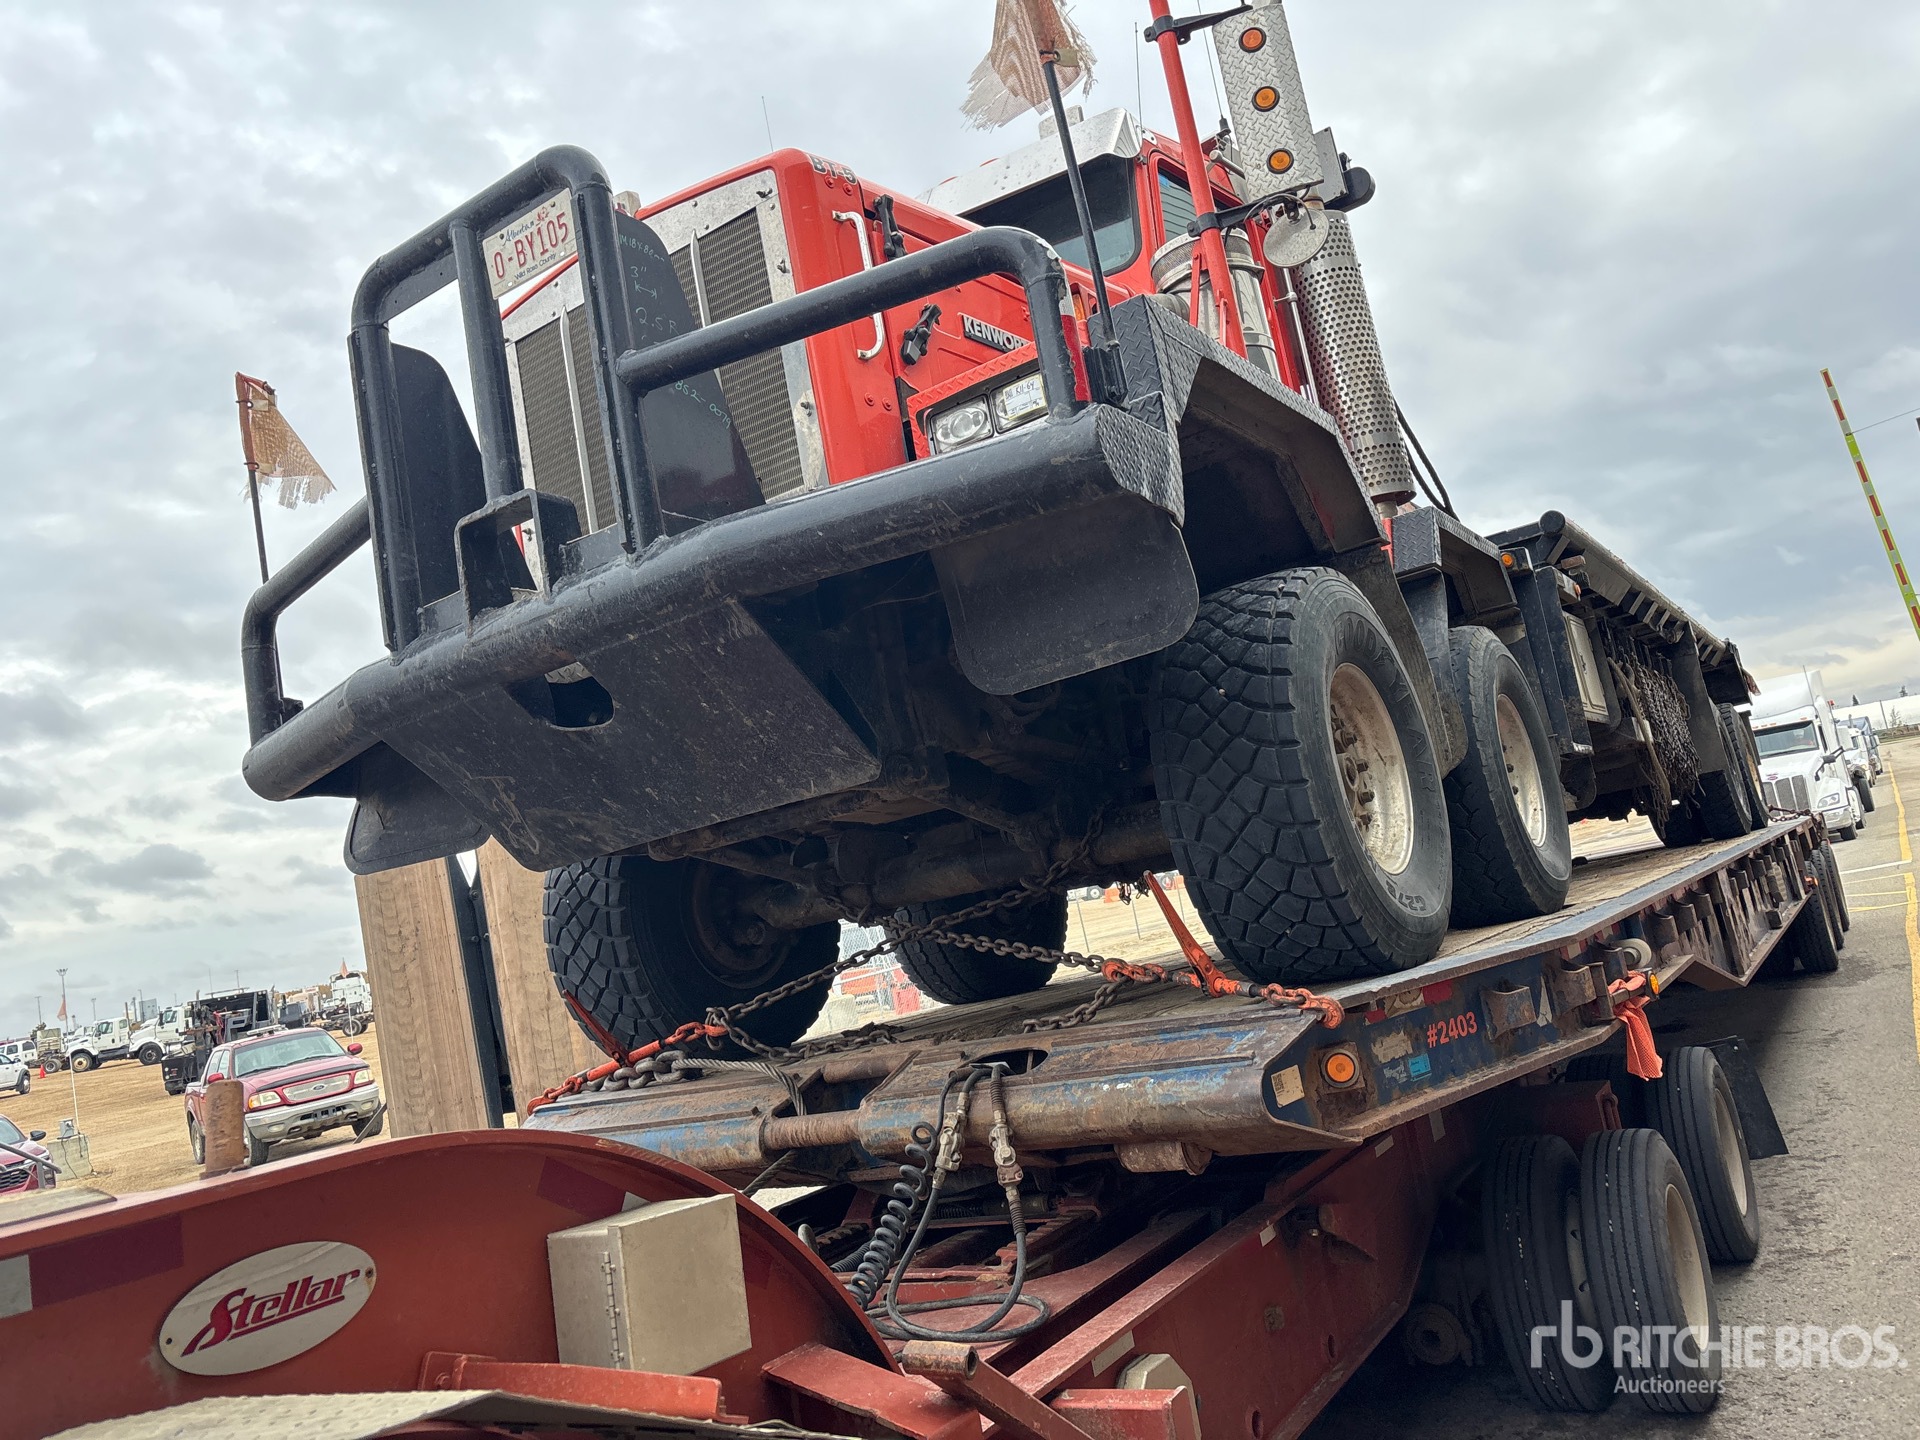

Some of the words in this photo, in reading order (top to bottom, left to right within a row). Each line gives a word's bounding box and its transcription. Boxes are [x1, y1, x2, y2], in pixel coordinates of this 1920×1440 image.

[514, 268, 527, 280] Wild
[539, 252, 557, 267] County
[963, 314, 1030, 350] KENWOR
[1426, 1011, 1478, 1048] #2403
[181, 1268, 361, 1357] Stellar
